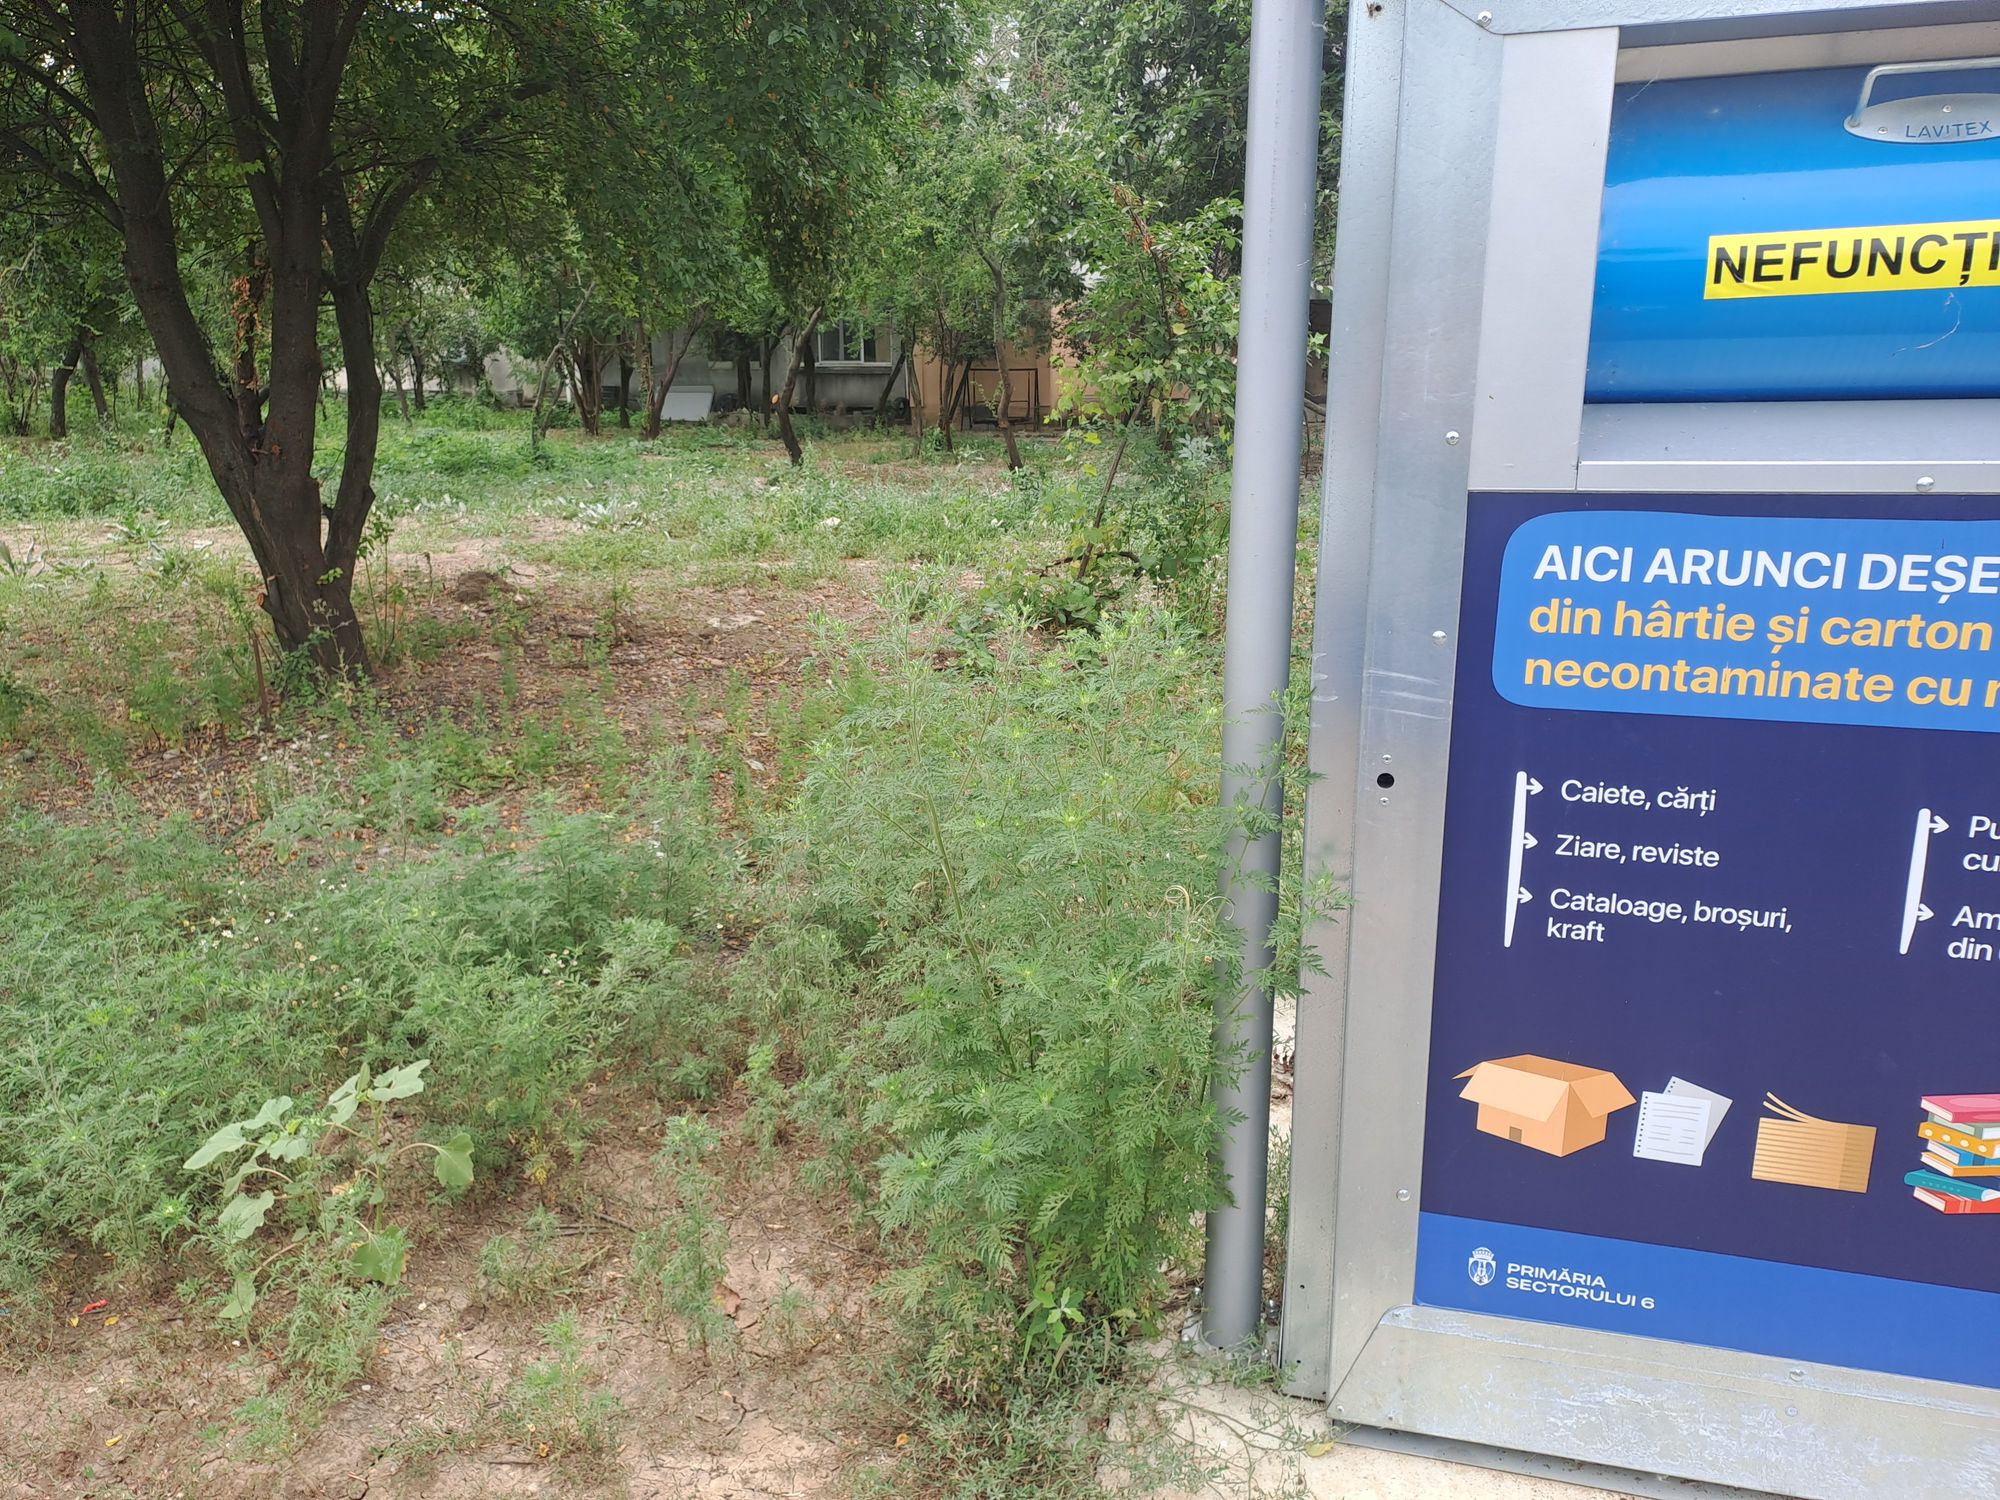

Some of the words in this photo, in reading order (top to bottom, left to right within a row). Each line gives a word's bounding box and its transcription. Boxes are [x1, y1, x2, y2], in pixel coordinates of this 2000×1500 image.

[1905, 120, 1993, 138] LAVITEX
[1533, 545, 1634, 583] AICI
[1643, 548, 1847, 589] ARUNCI
[1858, 553, 2000, 604] DEȘE
[1529, 598, 1602, 635] din
[1614, 600, 1756, 642] hârtie
[1767, 607, 1809, 654] și
[1820, 614, 1993, 651] carton
[1524, 659, 1894, 703] necontaminate
[1906, 676, 1973, 707] cu
[1561, 779, 1651, 811] Caiete,
[1656, 785, 1717, 817] cărți
[1554, 833, 1626, 864] Ziare,
[1632, 842, 1720, 868] reviste
[1550, 888, 1688, 924] Cataloage,
[1693, 900, 1792, 933] broșuri,
[1547, 916, 1606, 943] kraft
[1947, 937, 1993, 961] din
[1507, 1262, 1606, 1288] PRIMĂRIA
[1506, 1277, 1636, 1307] SECTORULUI
[1640, 1297, 1655, 1310] 6
